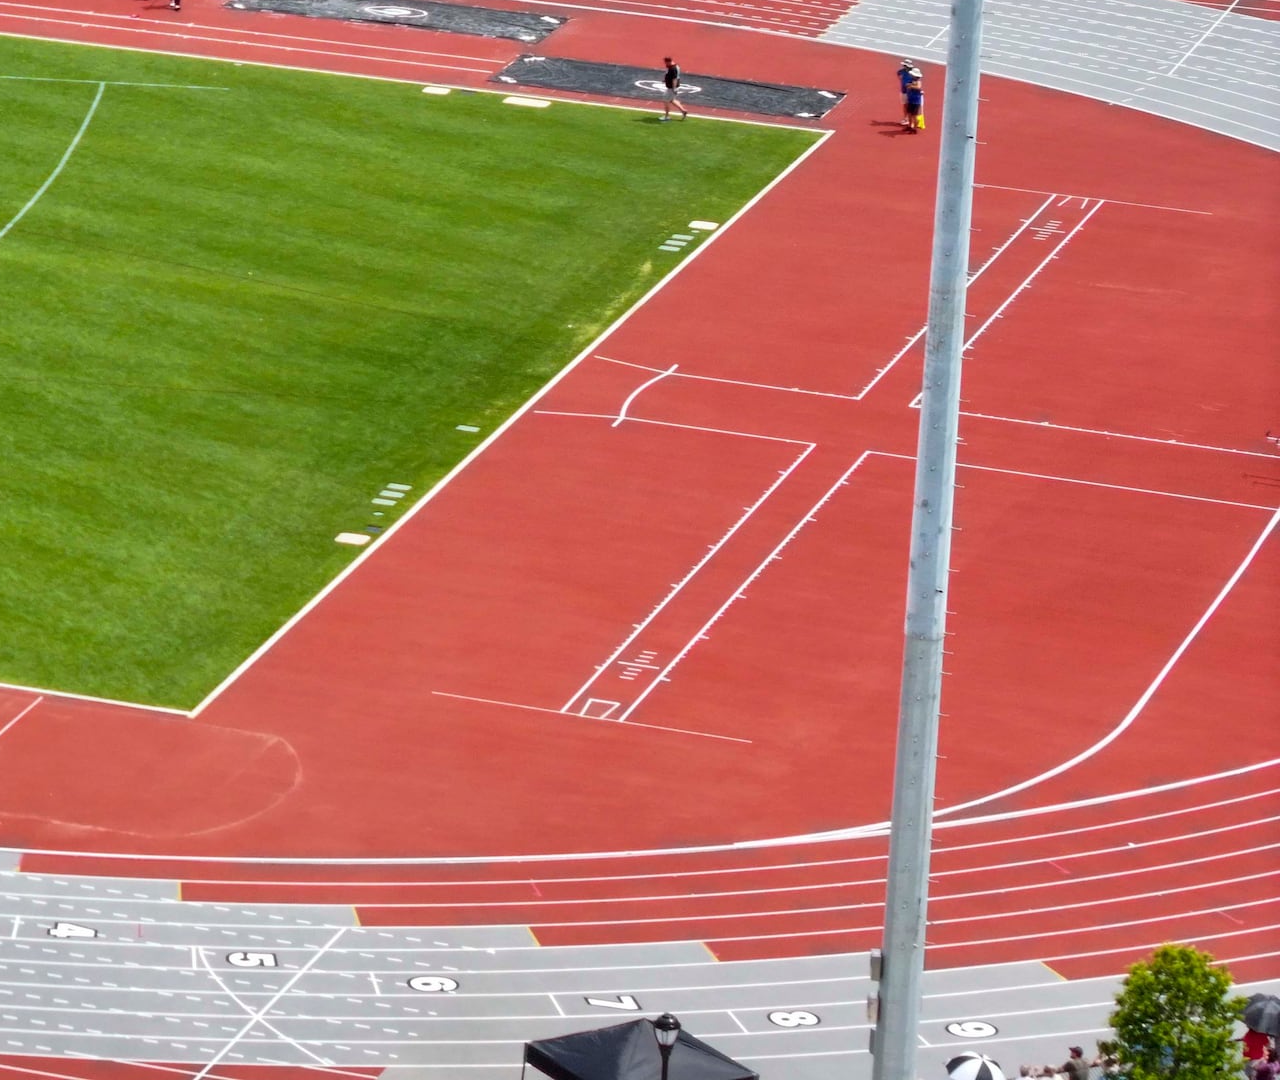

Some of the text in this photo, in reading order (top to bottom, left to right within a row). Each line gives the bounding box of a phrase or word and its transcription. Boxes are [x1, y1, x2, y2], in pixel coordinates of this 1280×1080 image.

[47, 922, 99, 939] 4
[226, 952, 279, 967] 5
[407, 975, 460, 993] 6
[584, 995, 643, 1011] 7
[768, 1010, 821, 1027] 8
[945, 1021, 998, 1038] 9
